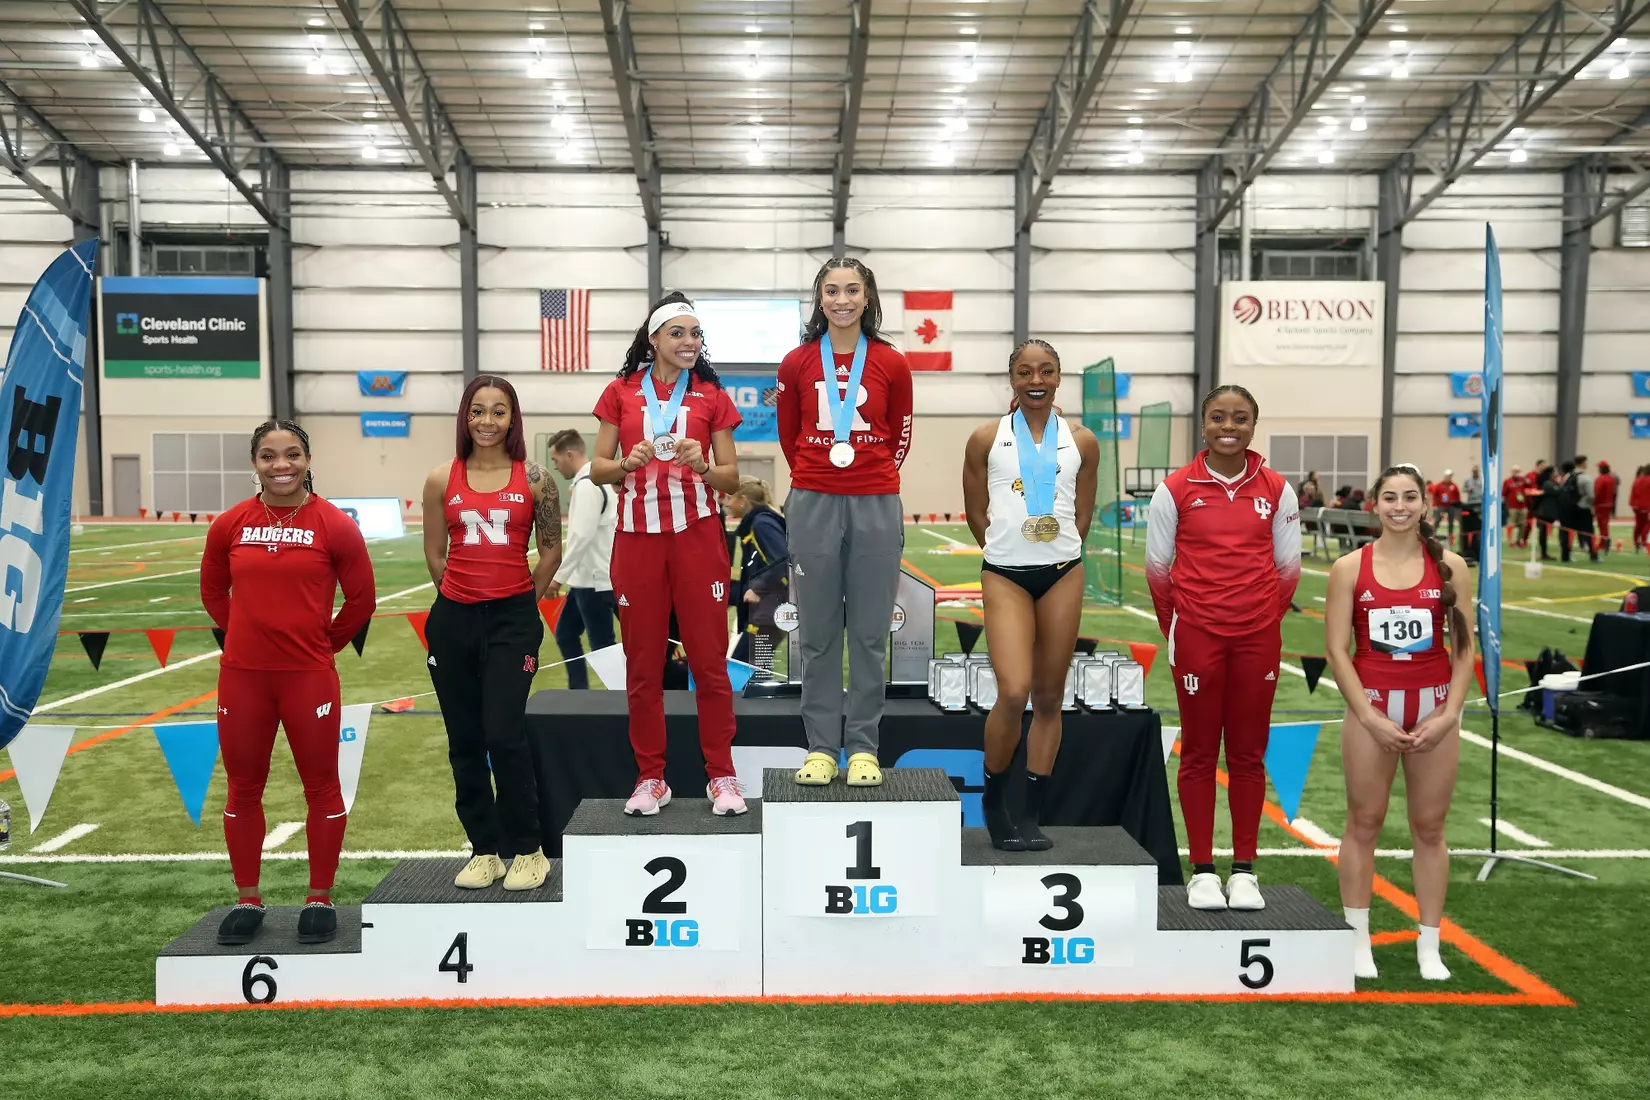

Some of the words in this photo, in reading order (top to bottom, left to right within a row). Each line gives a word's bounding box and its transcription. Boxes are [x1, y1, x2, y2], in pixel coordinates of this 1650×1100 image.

[1267, 300, 1376, 321] BEYNON
[141, 317, 206, 331] Cleveland
[208, 317, 246, 331] Clinic
[142, 335, 169, 345] Sports
[171, 335, 198, 345] Health
[144, 364, 222, 377] sports-health.org
[805, 436, 836, 445] RACK
[241, 526, 315, 545] BADGERS
[459, 508, 511, 546] N
[1379, 620, 1422, 640] 130
[316, 702, 332, 719] W
[846, 821, 880, 879] 1
[642, 856, 687, 913] 2
[1038, 873, 1084, 931] 3
[439, 932, 473, 983] 4
[1238, 938, 1274, 989] 5
[242, 955, 278, 1004] 6
